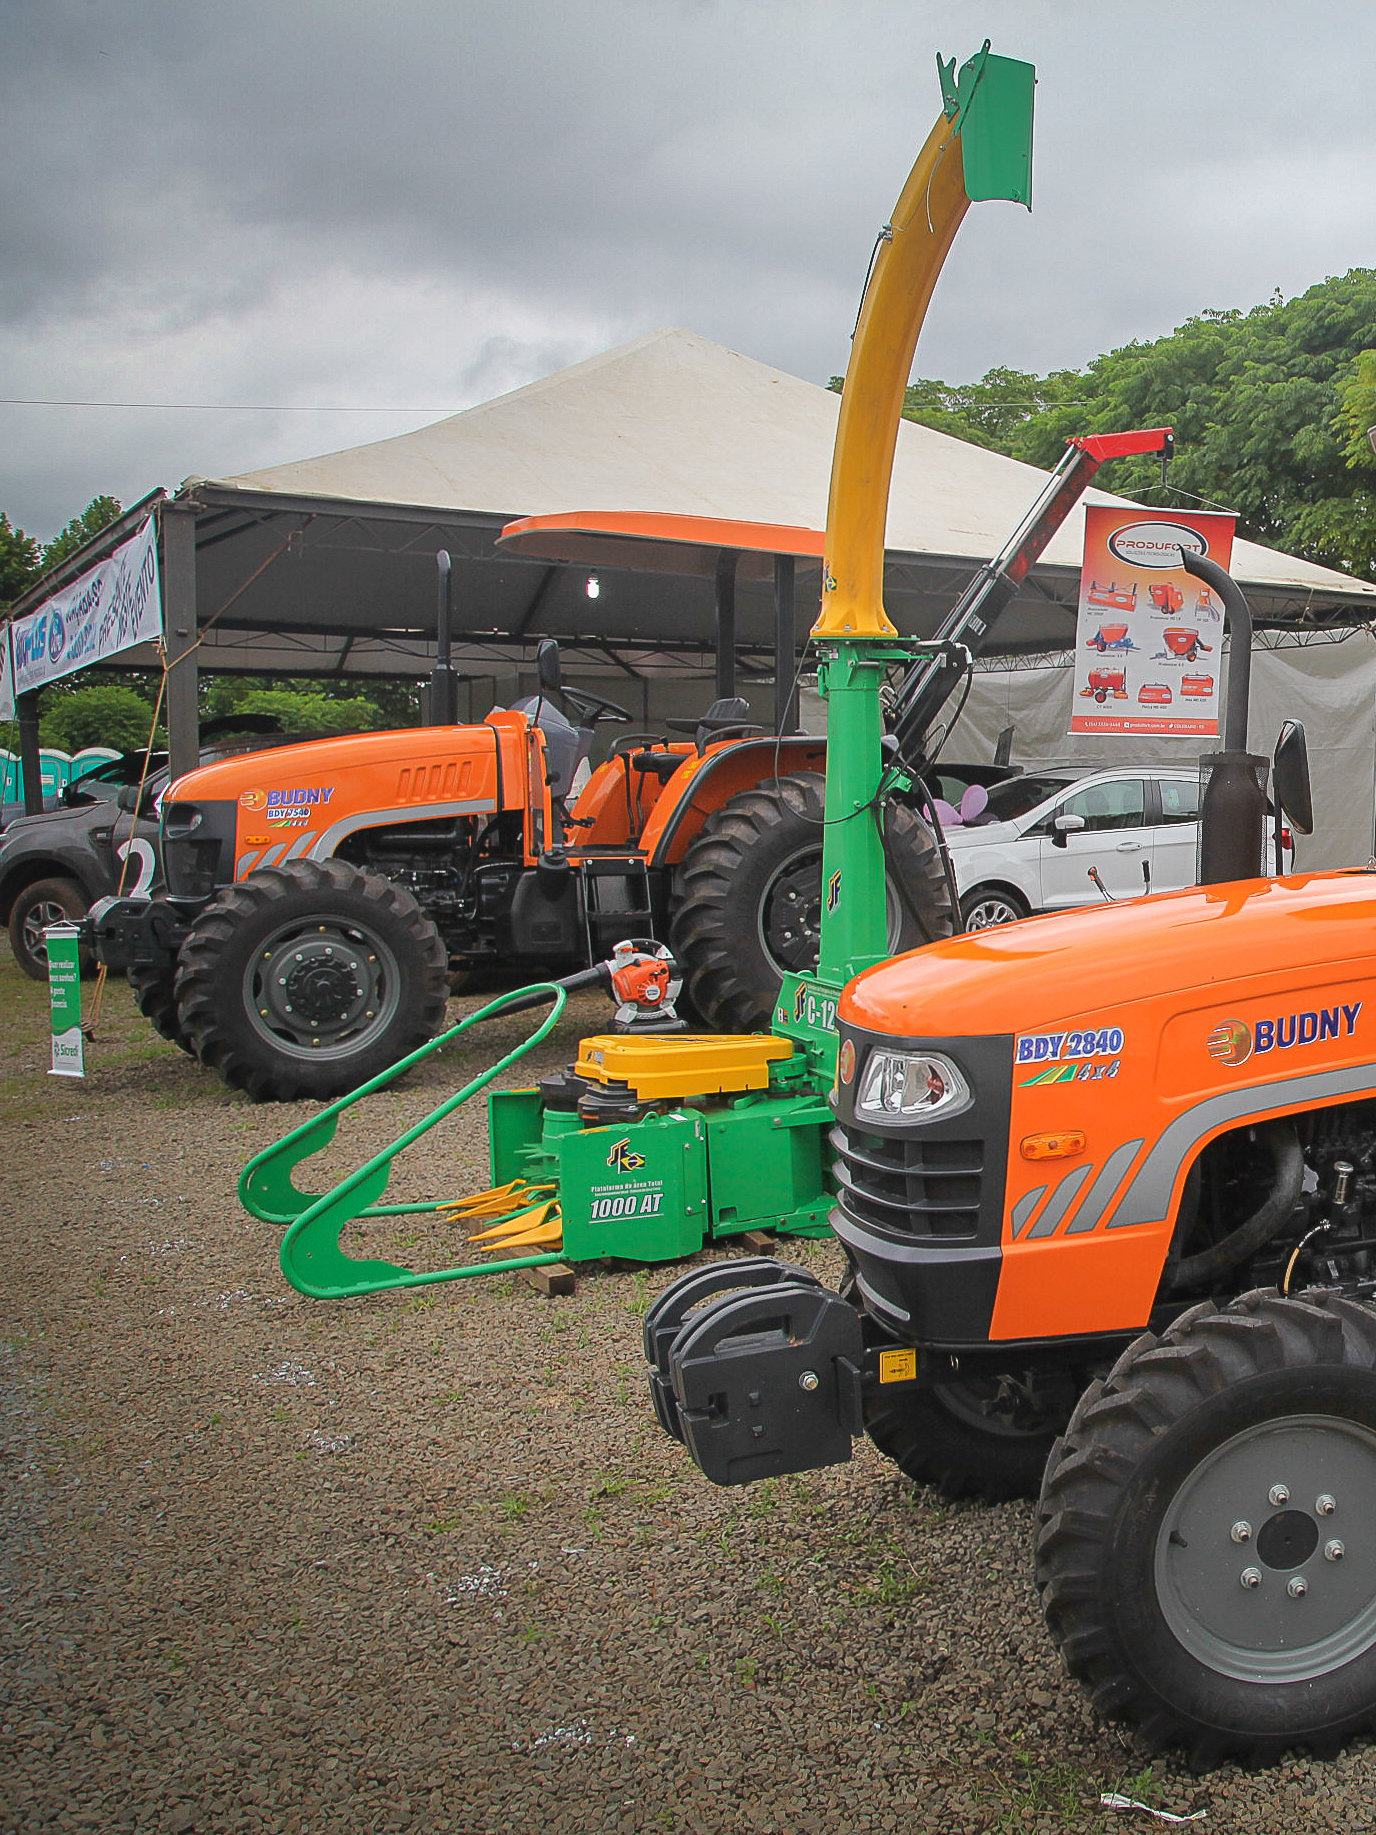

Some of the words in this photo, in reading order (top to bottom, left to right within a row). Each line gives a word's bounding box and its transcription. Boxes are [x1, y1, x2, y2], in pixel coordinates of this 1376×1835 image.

[267, 787, 335, 807] BUDNY
[266, 808, 287, 819] BDY
[1253, 1002, 1363, 1055] BUDNY
[1016, 1034, 1064, 1062] BDY
[1064, 1028, 1124, 1058] 2840
[590, 1195, 637, 1219] 1000
[639, 1193, 664, 1214] AT
